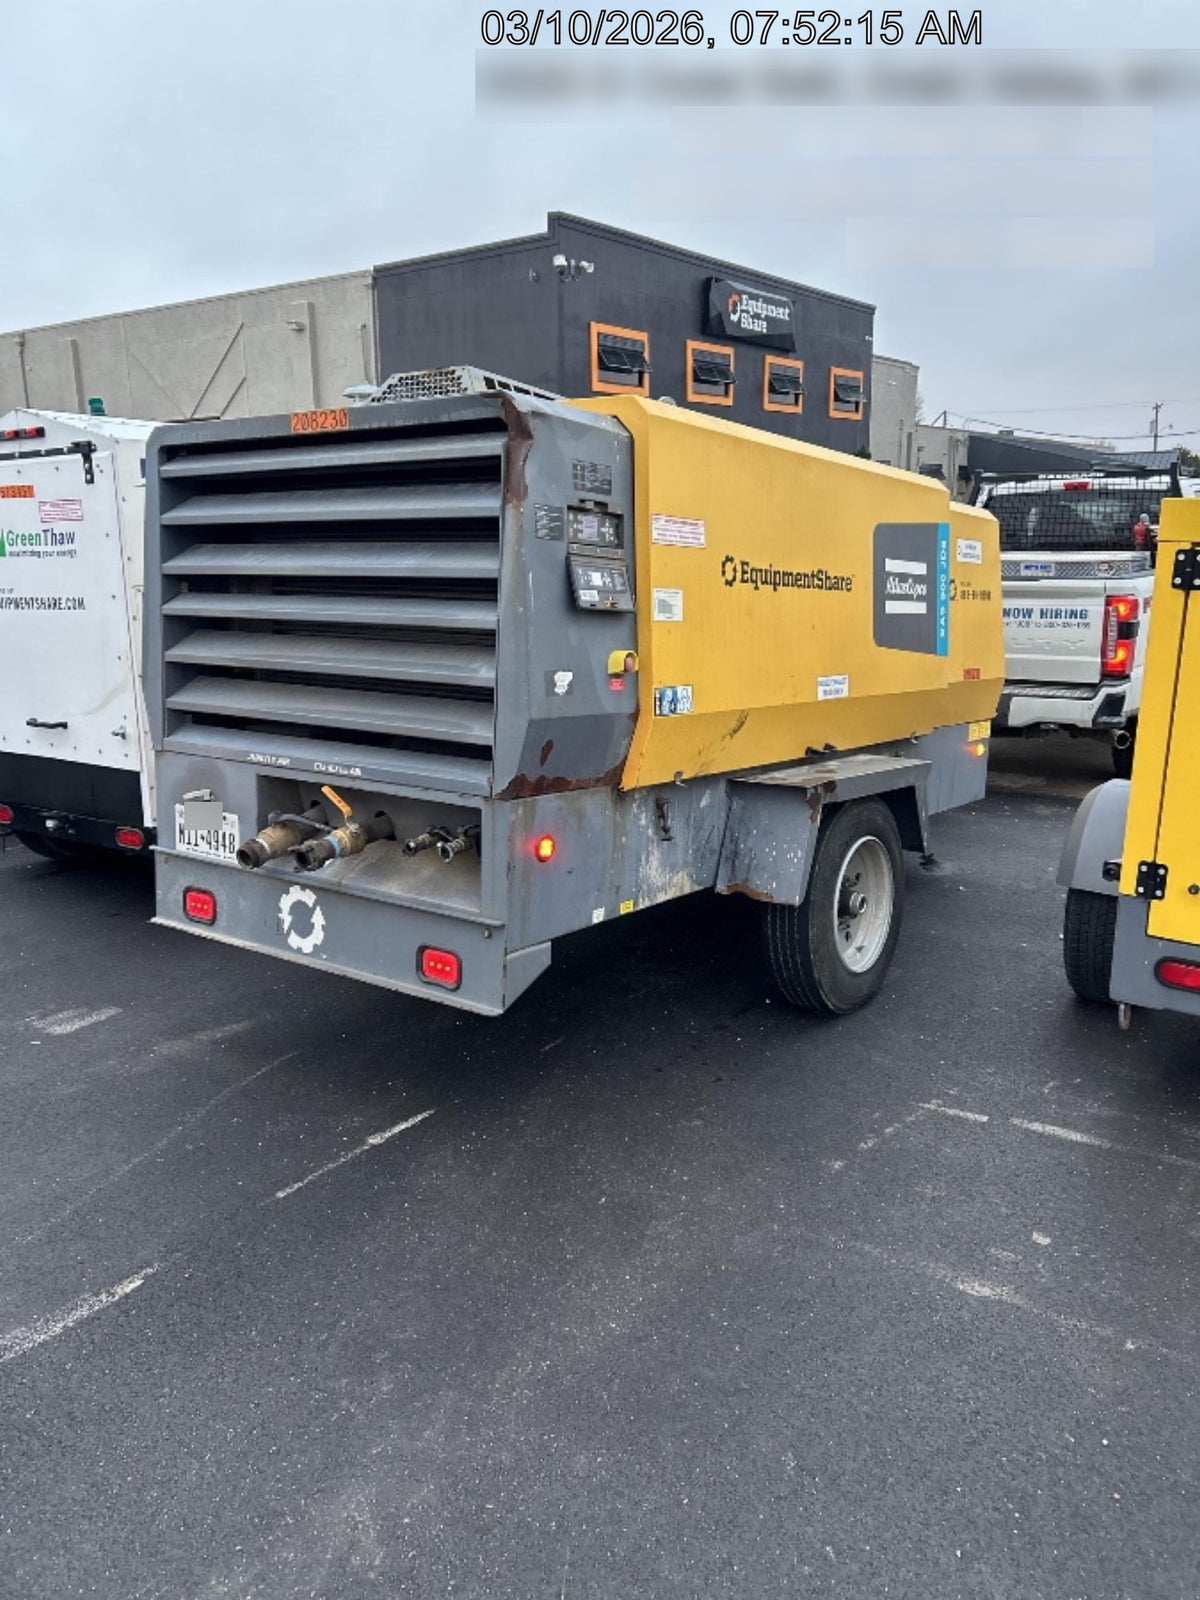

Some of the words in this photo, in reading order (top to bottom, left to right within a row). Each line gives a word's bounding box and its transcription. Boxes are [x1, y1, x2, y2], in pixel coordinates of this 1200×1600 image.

[740, 294, 790, 321] Equipment
[6, 528, 75, 547] GreenThaw
[740, 559, 853, 592] EquipmentShare
[1003, 607, 1034, 619] NOW
[1040, 607, 1088, 620] HIRING
